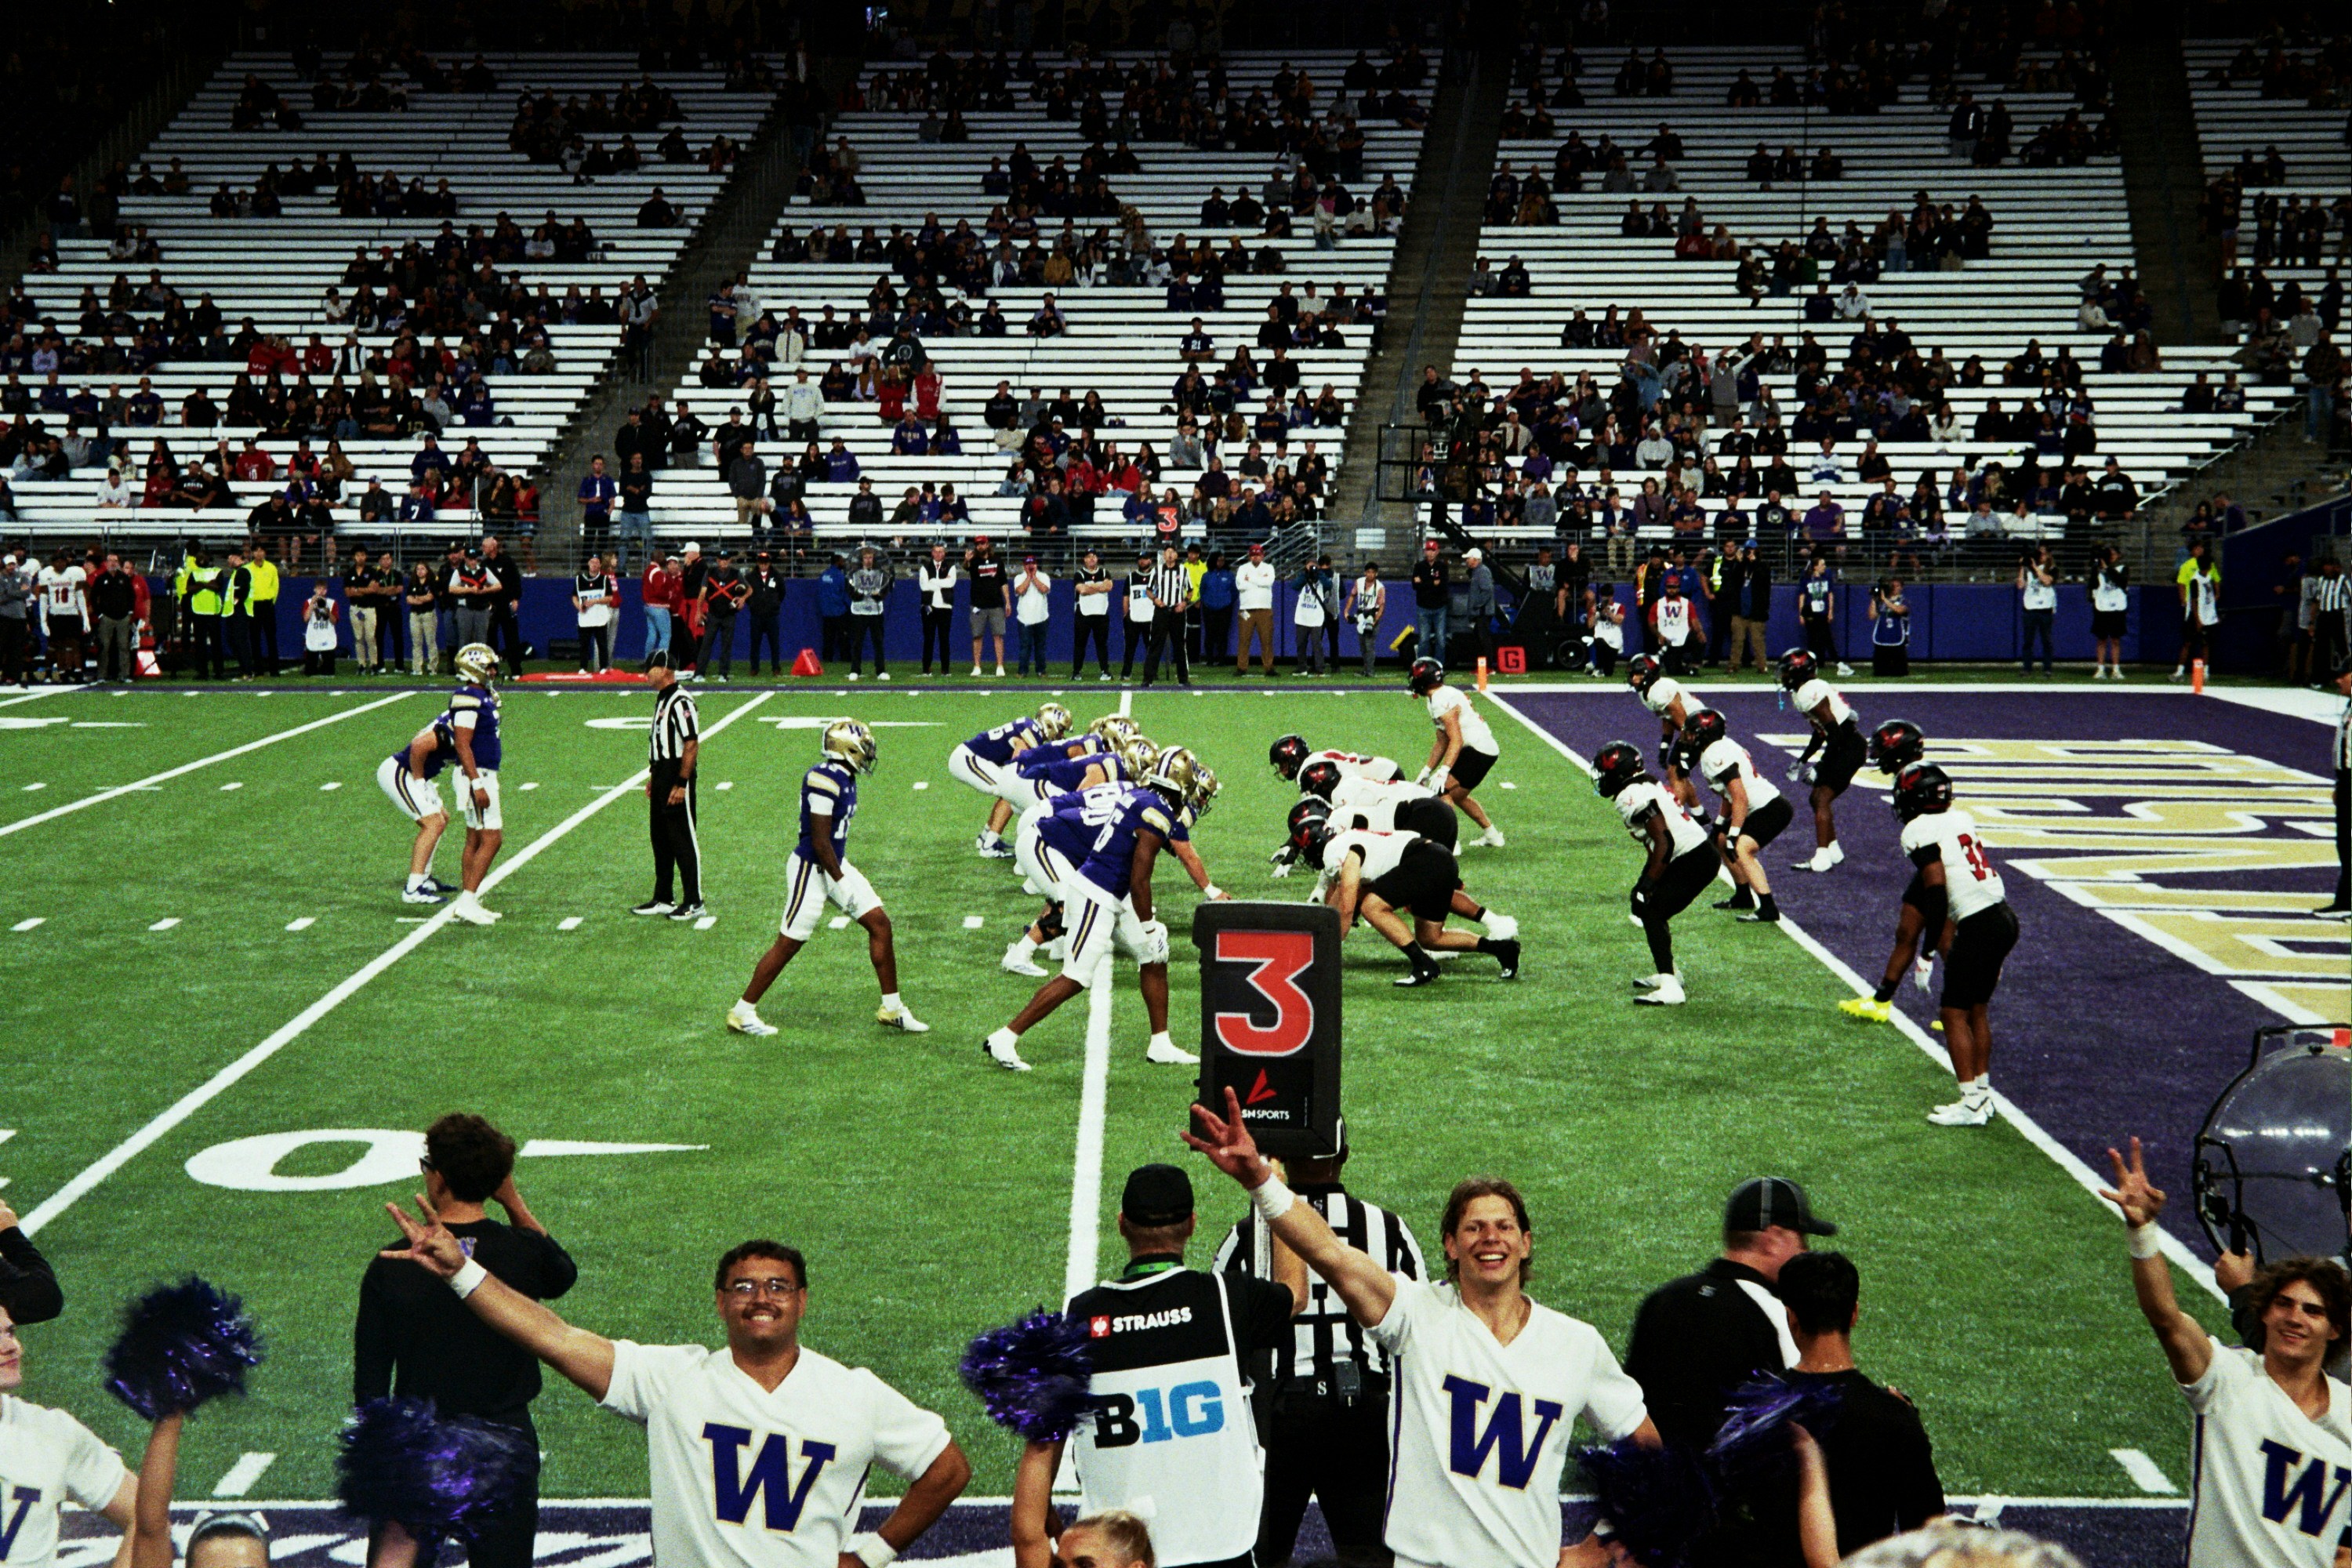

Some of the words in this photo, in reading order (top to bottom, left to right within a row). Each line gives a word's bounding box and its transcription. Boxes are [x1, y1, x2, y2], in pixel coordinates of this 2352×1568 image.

[411, 505, 419, 520] 7
[1157, 506, 1178, 532] 3
[1537, 570, 1553, 581] W
[1664, 606, 1682, 619] W
[1504, 651, 1520, 670] G
[1214, 930, 1314, 1057] 3
[1256, 1109, 1290, 1120] SPORTS
[1112, 1306, 1192, 1333] STRAUSS
[1317, 1381, 1327, 1396] S
[1440, 1374, 1564, 1490] W
[701, 1421, 837, 1533] W
[2259, 1437, 2351, 1538] W
